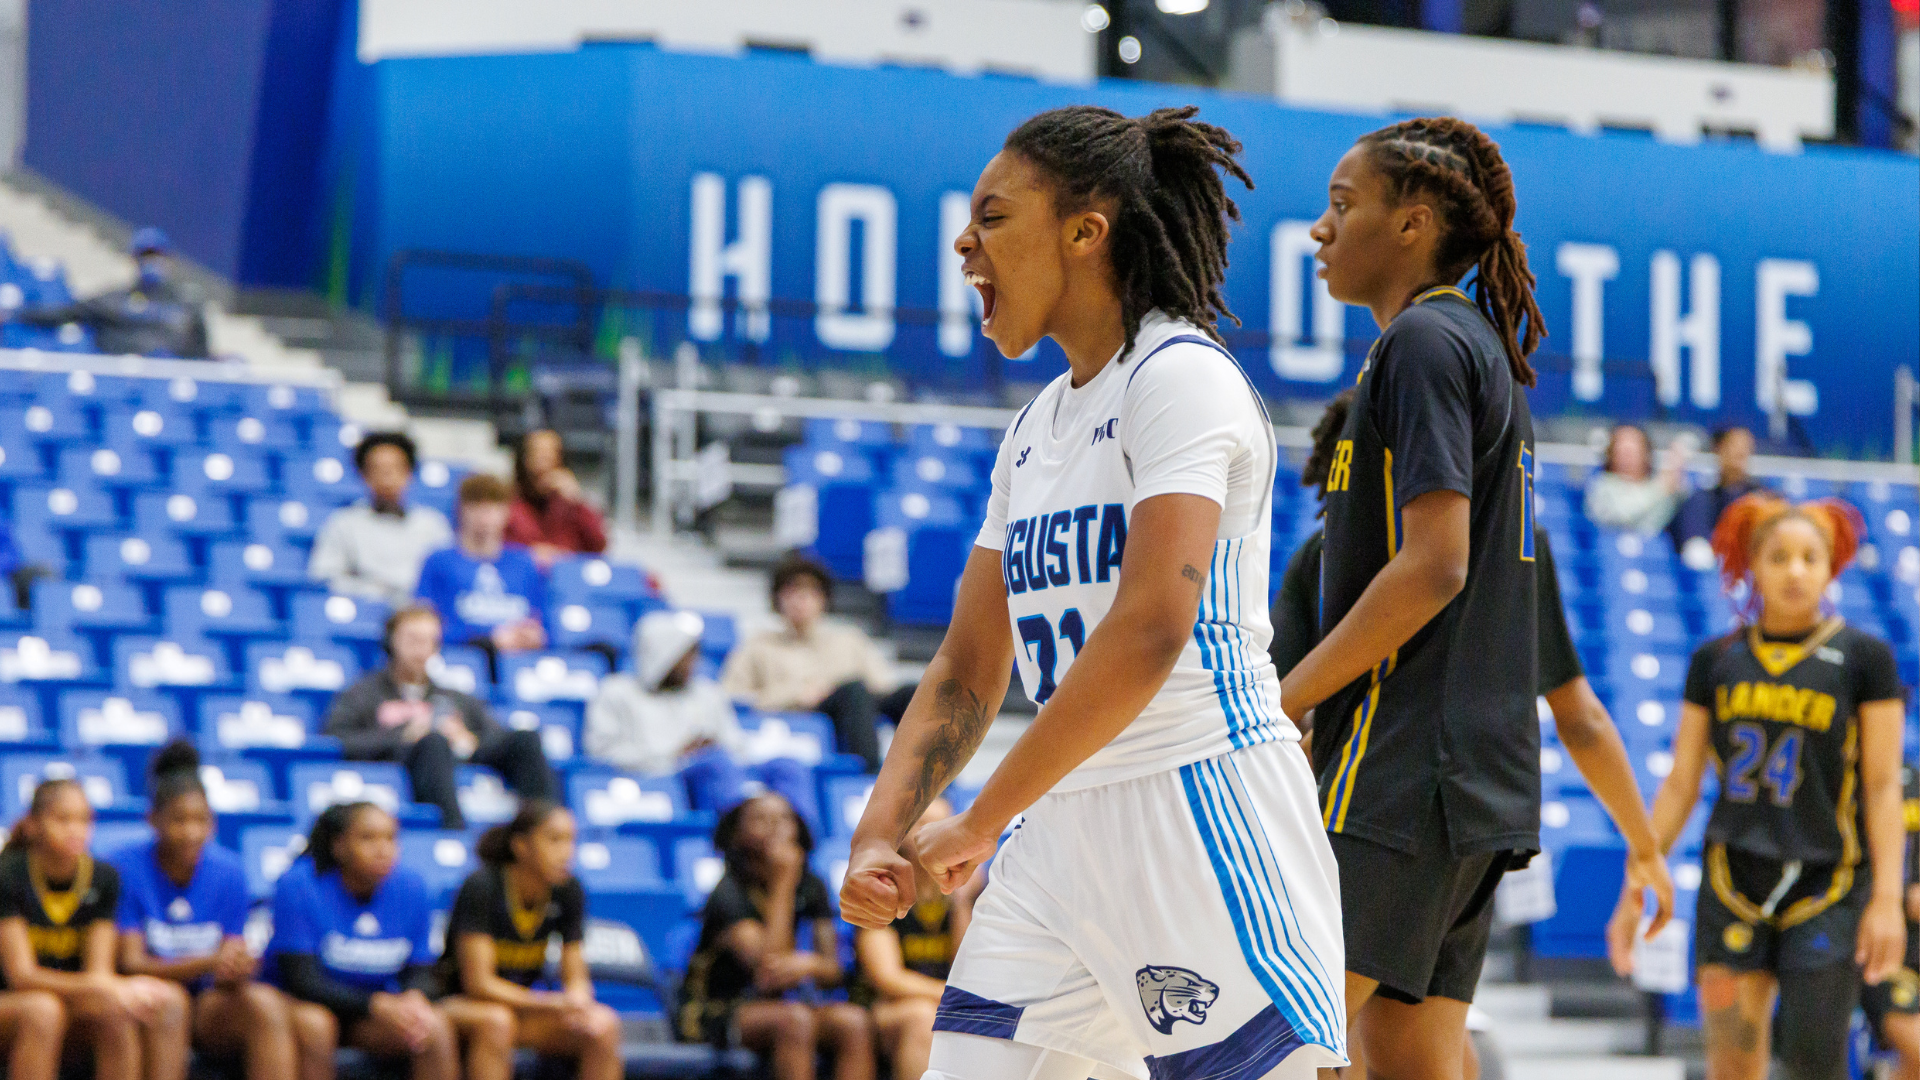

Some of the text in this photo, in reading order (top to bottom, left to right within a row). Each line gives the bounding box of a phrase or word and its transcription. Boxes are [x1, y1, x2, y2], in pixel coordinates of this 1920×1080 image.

[1556, 241, 1820, 417] THE
[1715, 680, 1837, 733] LANDER
[1725, 720, 1805, 808] 24
